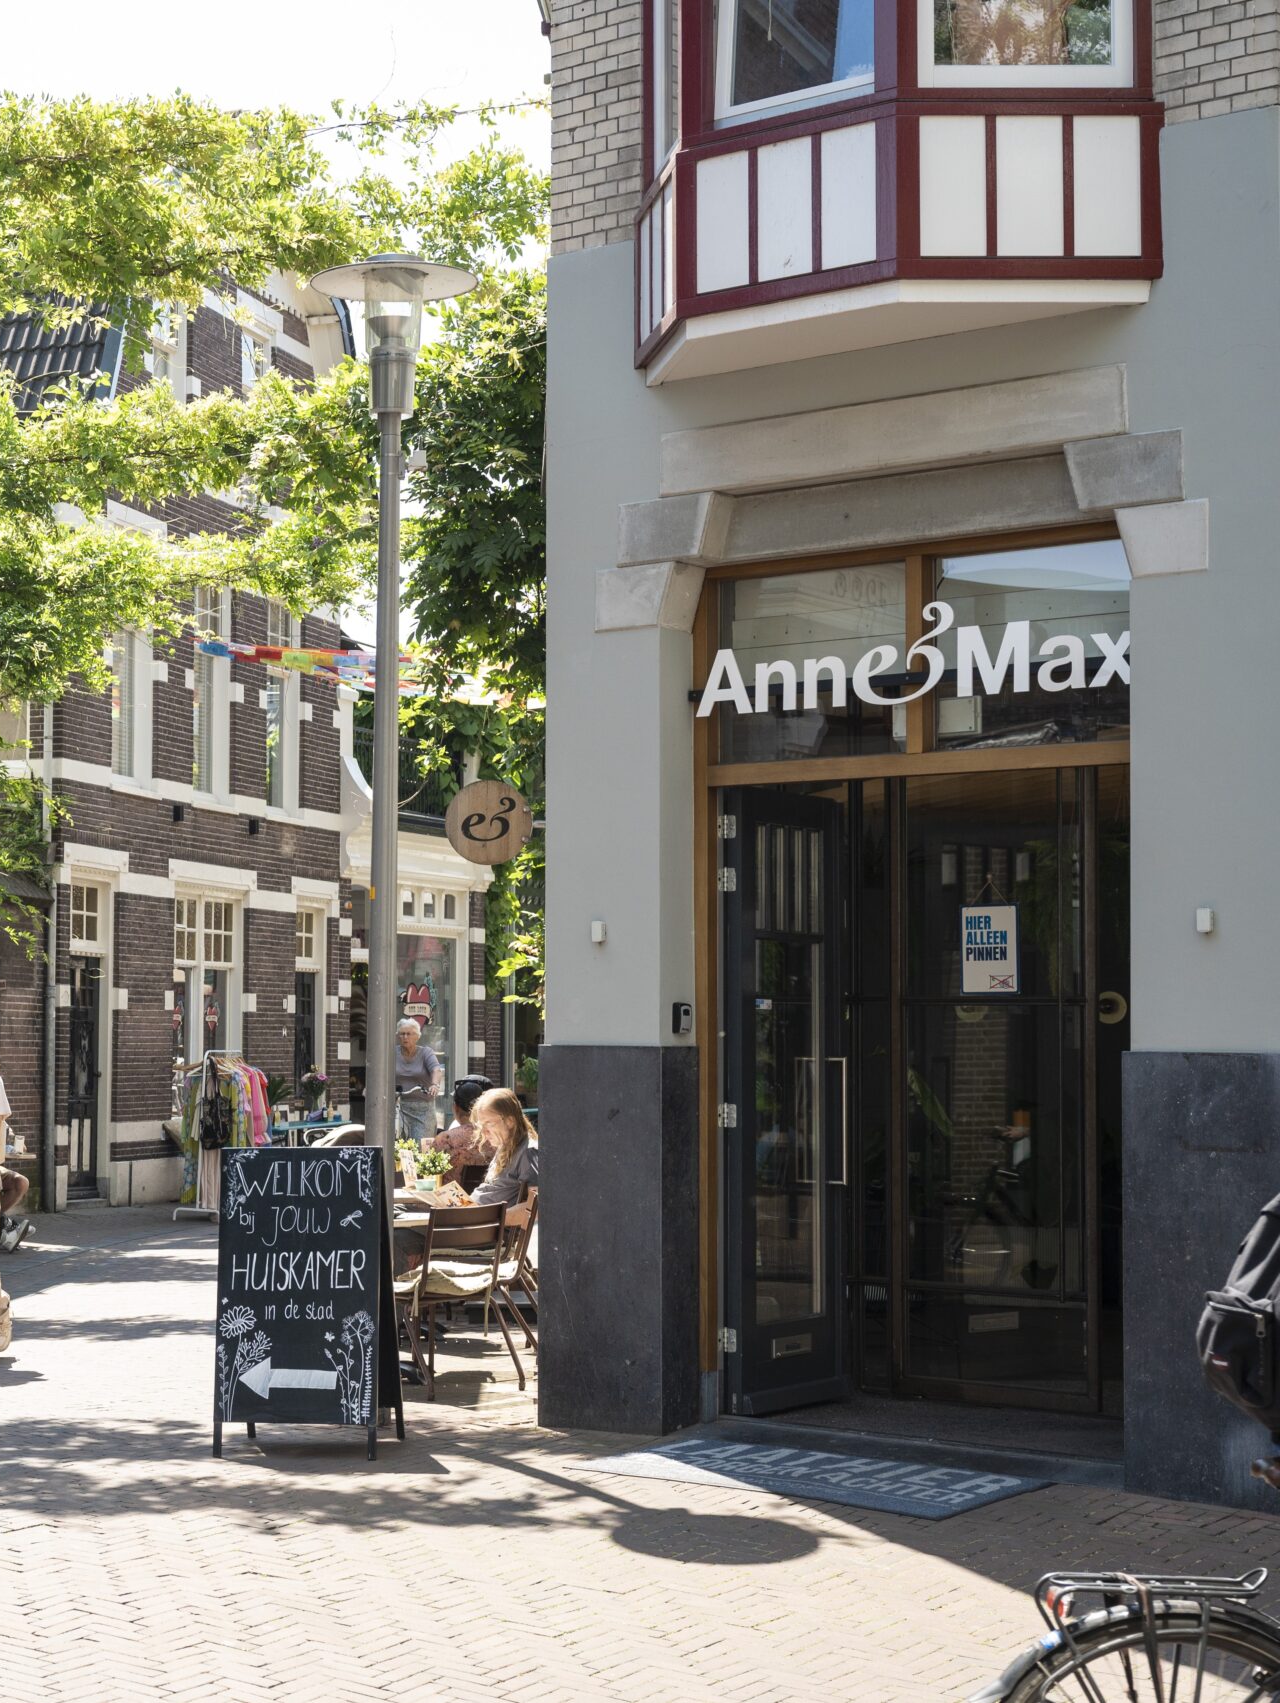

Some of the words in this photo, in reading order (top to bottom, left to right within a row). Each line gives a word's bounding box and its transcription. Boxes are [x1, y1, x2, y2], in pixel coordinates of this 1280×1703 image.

[966, 915, 991, 930] HIER
[966, 931, 1007, 945] ALLEEN
[966, 946, 1007, 961] PINNEN
[235, 1160, 362, 1198] WELKOM
[239, 1206, 256, 1234] bij
[231, 1249, 366, 1291] HUISKAMER
[265, 1305, 276, 1320] in
[284, 1298, 301, 1320] de
[305, 1300, 335, 1320] stad
[649, 1439, 846, 1466] LAAT
[821, 1458, 1021, 1495] HIER
[813, 1471, 976, 1504] ACHTER
